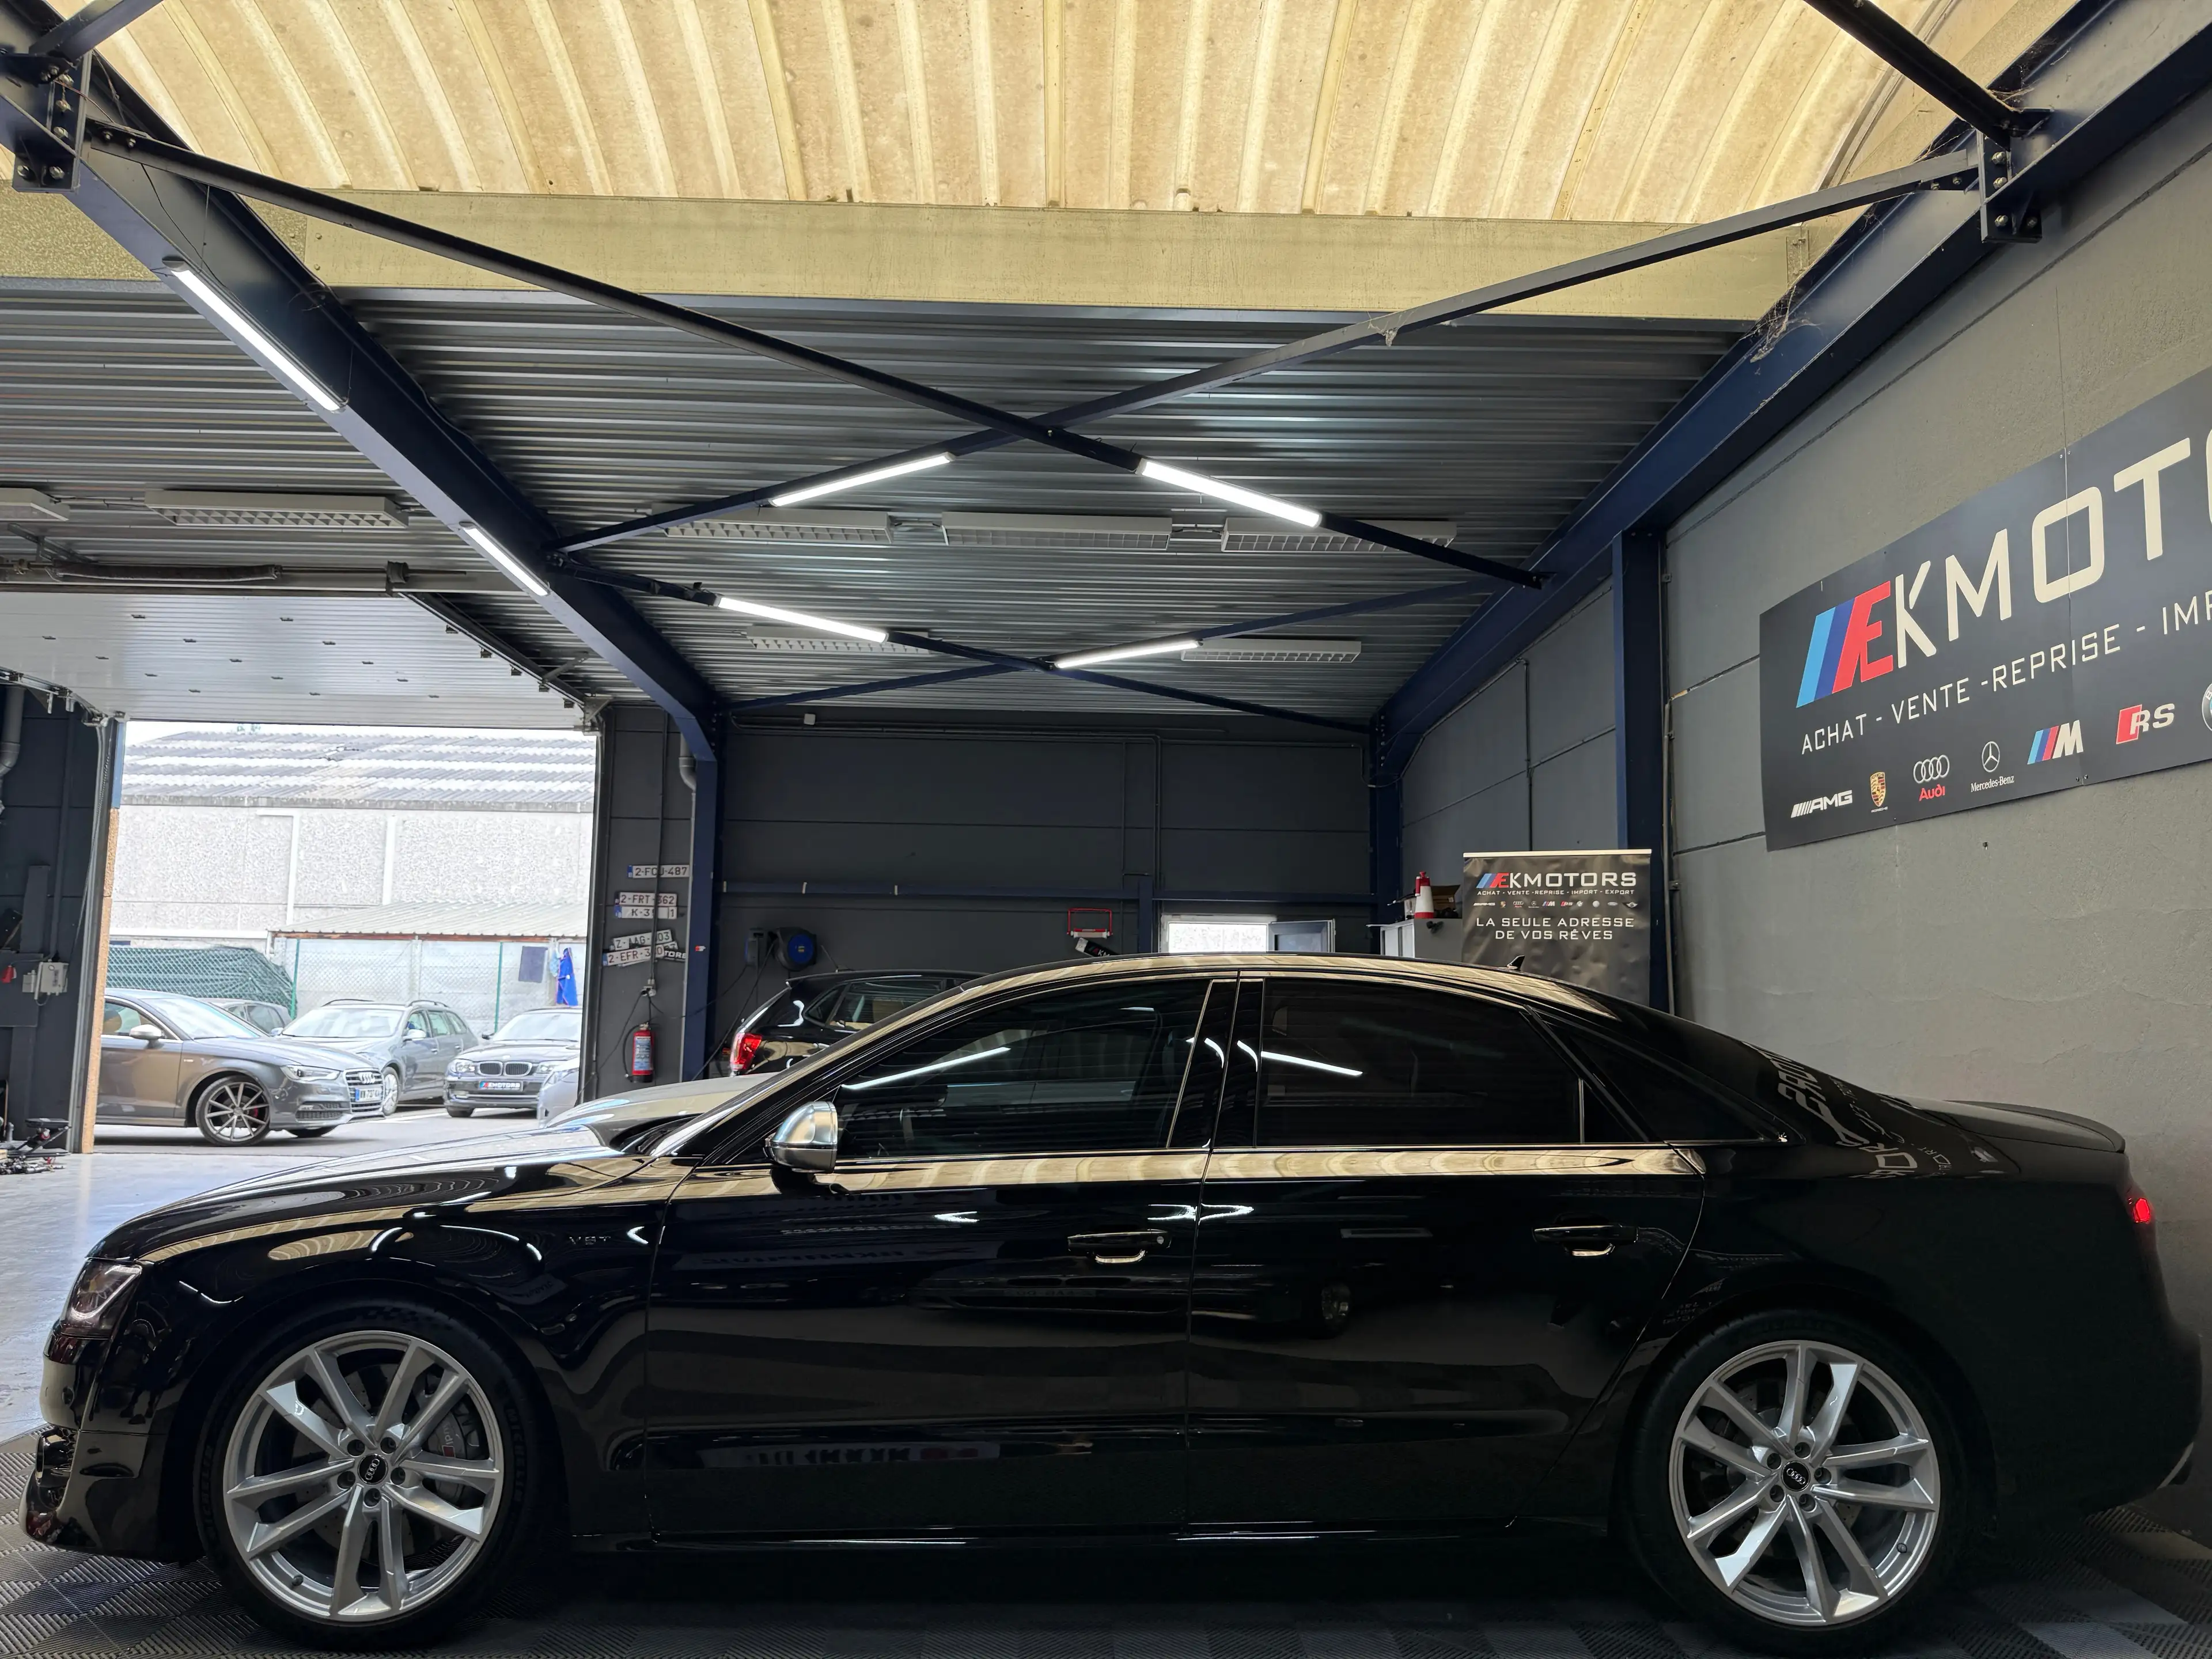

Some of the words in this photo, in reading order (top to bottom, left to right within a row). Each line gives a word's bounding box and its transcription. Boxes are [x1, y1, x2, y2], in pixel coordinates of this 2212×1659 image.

[1832, 425, 2212, 693] EKMOT
[1802, 713, 1867, 754] ACHAT
[1891, 677, 1970, 722] VENTE
[2130, 703, 2175, 735] RS
[1919, 783, 1945, 802] Audi
[1971, 775, 2014, 793] Mercedes-Benz
[1490, 872, 1636, 888] EKMOTORS
[621, 895, 675, 904] 2-FRT-362
[1476, 918, 1495, 926] LA
[1502, 918, 1551, 926] SEULE
[1557, 917, 1634, 927] ADRESSE
[1495, 930, 1514, 940] DE
[1521, 930, 1552, 940] VOS
[608, 946, 662, 963] 2-EFR-30
